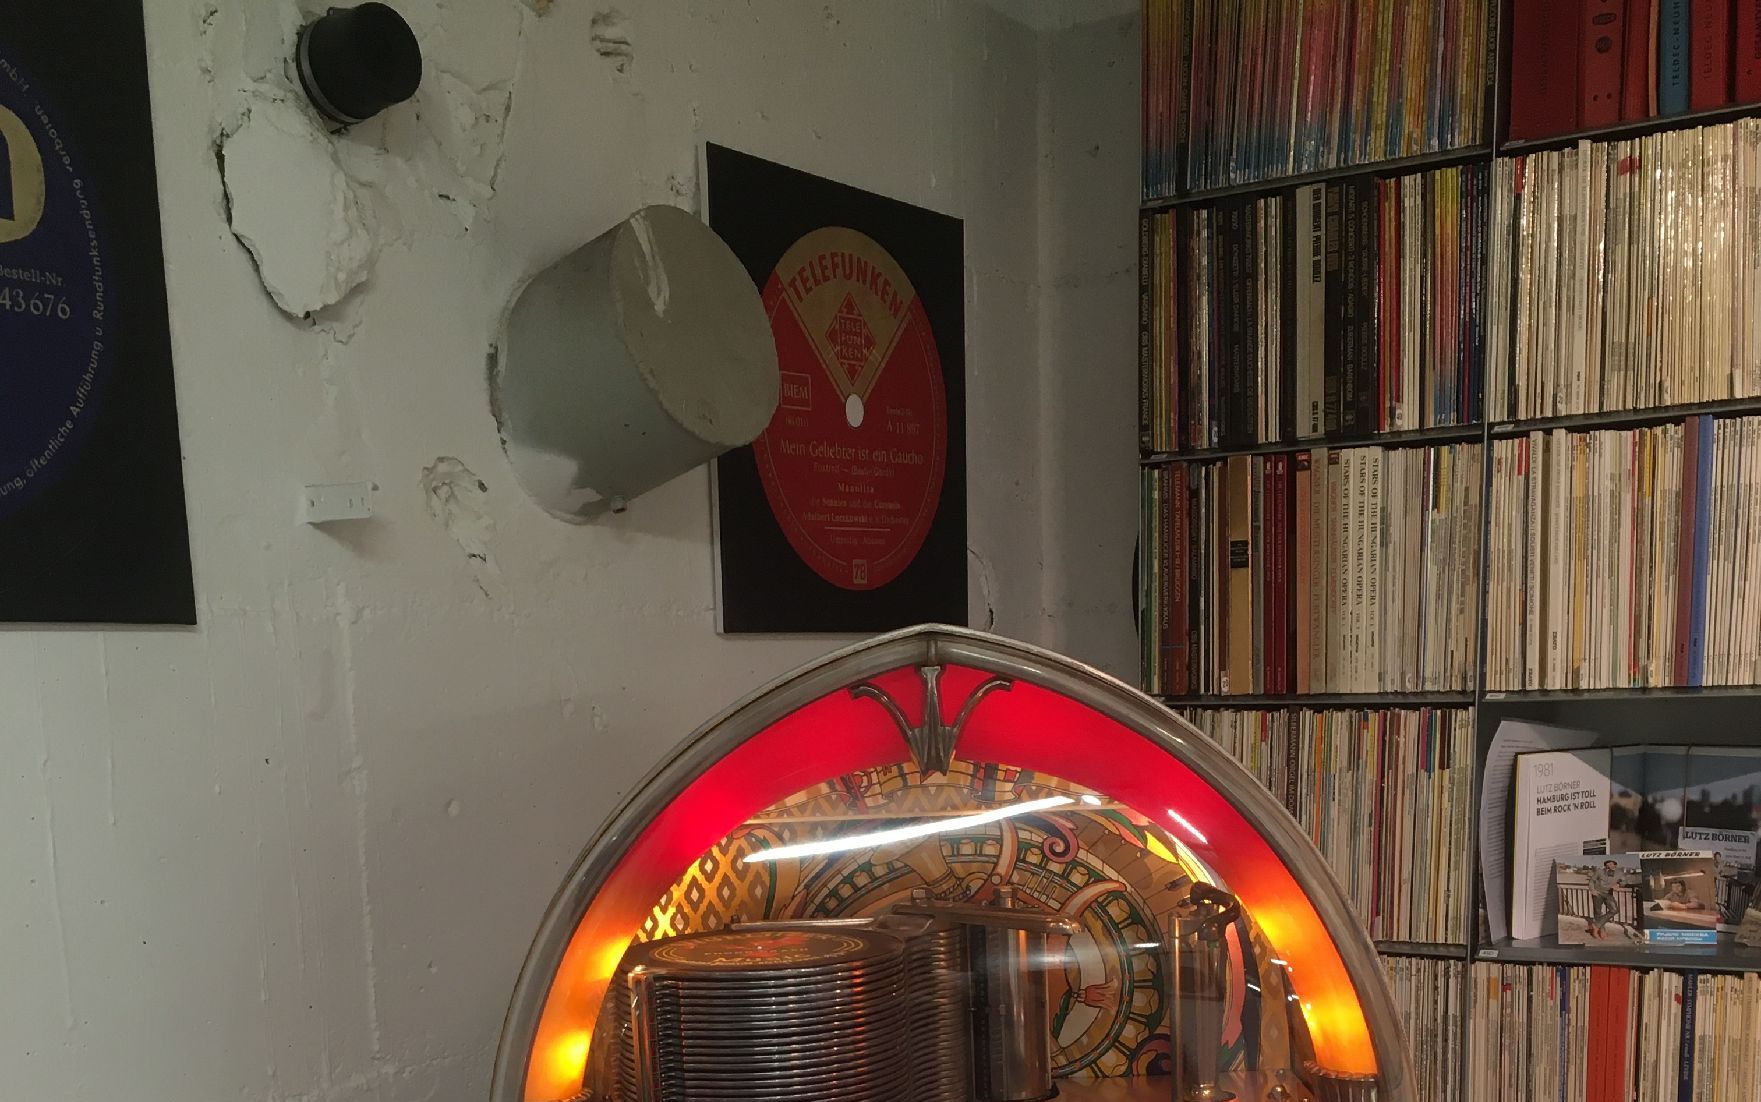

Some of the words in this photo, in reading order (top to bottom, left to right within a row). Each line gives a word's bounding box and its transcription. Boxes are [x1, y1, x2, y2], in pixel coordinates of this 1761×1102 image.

[788, 251, 903, 320] TELEFUNKEN
[841, 319, 862, 333] TELE
[841, 334, 862, 346] FUN
[841, 345, 863, 359] KEN
[784, 383, 809, 400] BIEM
[780, 439, 806, 456] Mein
[809, 440, 856, 461] Geliebter
[858, 446, 869, 461] ist
[872, 449, 887, 463] ein
[889, 448, 924, 465] Gaucho
[1341, 458, 1350, 485] STARS
[1358, 455, 1367, 483] STARS
[1370, 457, 1379, 485] STARS
[1341, 487, 1350, 500] OF
[1358, 485, 1367, 498] OF
[1370, 487, 1379, 500] OF
[1341, 502, 1350, 519] THE
[1357, 500, 1367, 517] THE
[1370, 502, 1379, 517] THE
[1341, 522, 1350, 574] HUNGARIAN
[1356, 520, 1367, 573] HUNGARIAN
[1370, 522, 1379, 574] HUNGARIAN
[1341, 576, 1350, 606] OPERA
[1356, 575, 1364, 605] OPERA
[1370, 576, 1379, 606] OPERA
[1288, 760, 1297, 784] ORGEL
[1534, 762, 1554, 778] 1981
[1537, 783, 1553, 795] LUTZ
[1554, 780, 1581, 792] BÖRNER
[1536, 793, 1570, 806] HAMBURG
[1570, 791, 1580, 801] IST
[1580, 789, 1597, 799] TOLL
[1536, 806, 1553, 817] BEIM
[1553, 804, 1572, 814] ROCK
[1580, 800, 1597, 810] ROLL
[1685, 831, 1710, 841] LUTZ
[1711, 832, 1750, 844] BÖRNER
